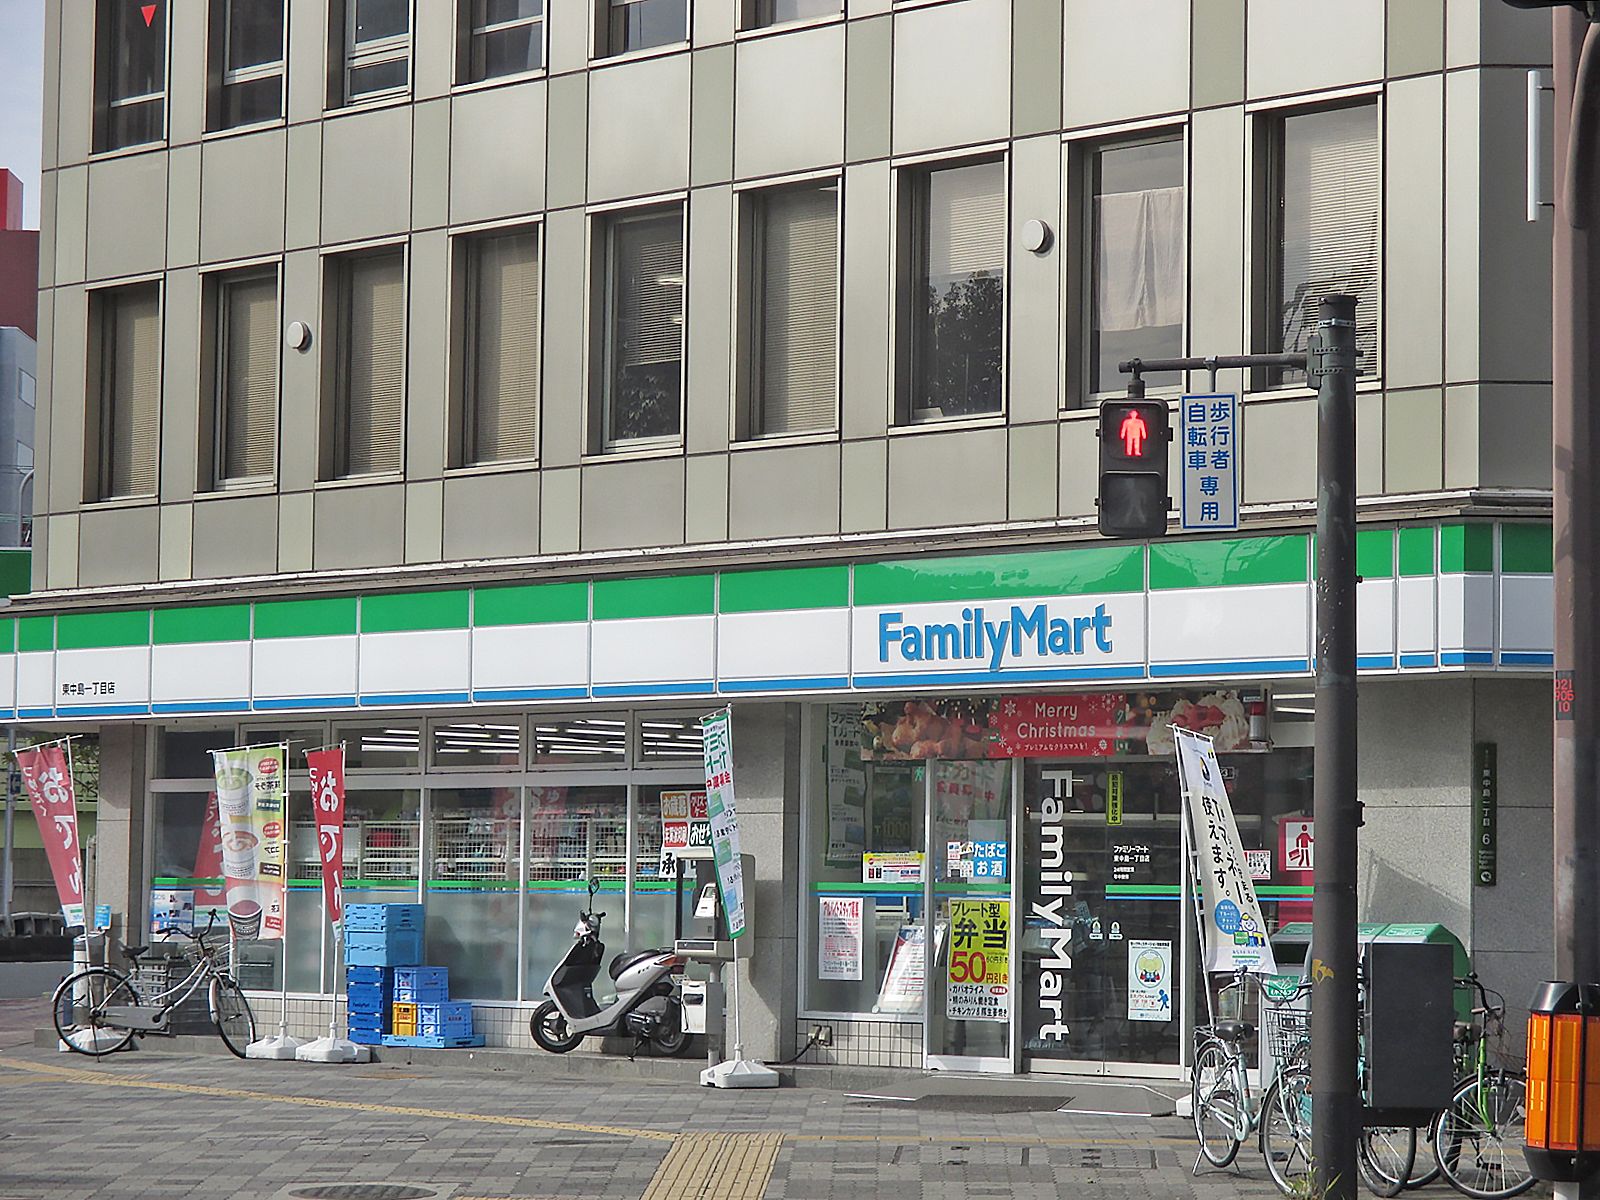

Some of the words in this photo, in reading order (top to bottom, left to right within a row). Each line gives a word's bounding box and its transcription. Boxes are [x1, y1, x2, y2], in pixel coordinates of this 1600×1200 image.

[1187, 403, 1207, 470] 自転車
[1210, 402, 1230, 470] 歩行者
[1200, 476, 1219, 521] 専用
[879, 603, 1112, 671] FamilyMart
[62, 681, 115, 695] 東中島一丁目店
[1035, 702, 1077, 720] Merry
[1559, 701, 1570, 712] 10
[1017, 722, 1096, 738] Christmas
[1482, 834, 1490, 845] 6
[974, 843, 1006, 858] たばこ
[976, 860, 1003, 876] お酒
[952, 903, 1000, 918] プレート型
[1032, 770, 1073, 1041] FamilyMart
[954, 918, 1007, 949] 弁当
[950, 951, 986, 983] 50
[986, 973, 1008, 984] 円引き
